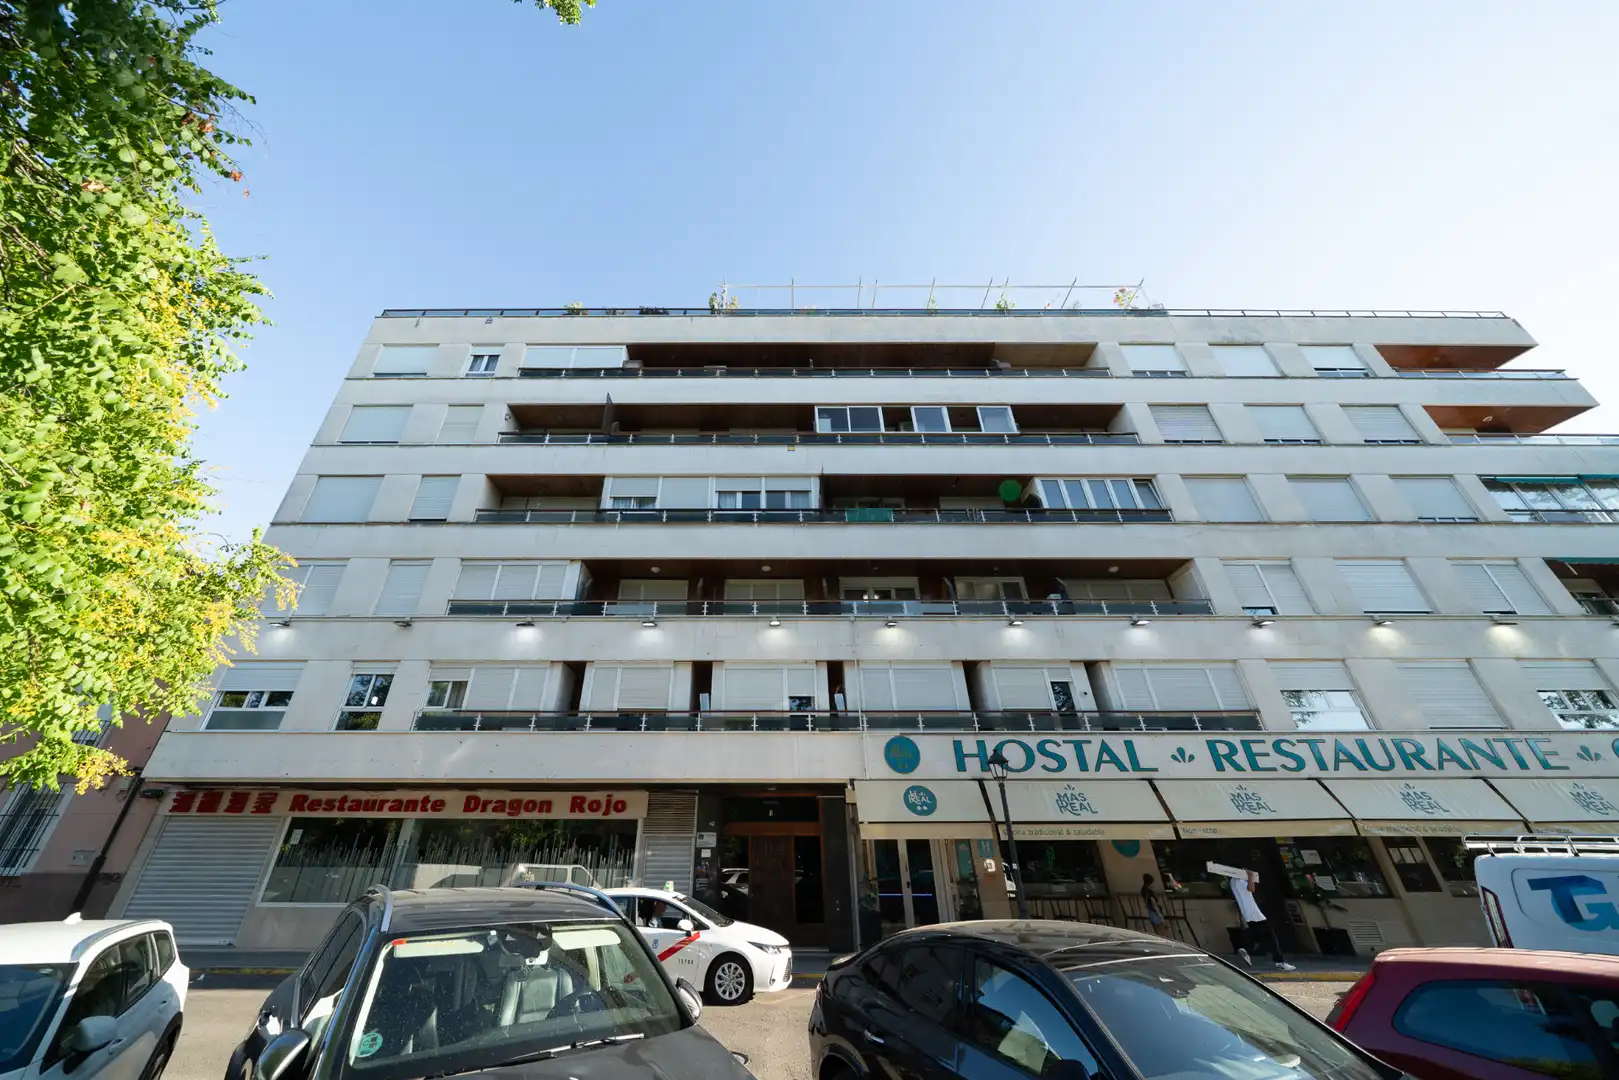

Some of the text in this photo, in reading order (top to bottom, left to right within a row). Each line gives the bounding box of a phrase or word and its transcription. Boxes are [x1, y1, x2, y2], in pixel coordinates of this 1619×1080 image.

[953, 739, 1159, 772] HOSTAL
[1206, 738, 1570, 772] RESTAURANTE
[288, 794, 445, 813] Restaurante
[463, 794, 552, 817] Dragon
[569, 793, 627, 816] Rojo
[1056, 799, 1098, 816] REAL
[1231, 798, 1277, 815] REAL
[1004, 828, 1025, 836] Ccina
[1029, 828, 1064, 836] tradicional
